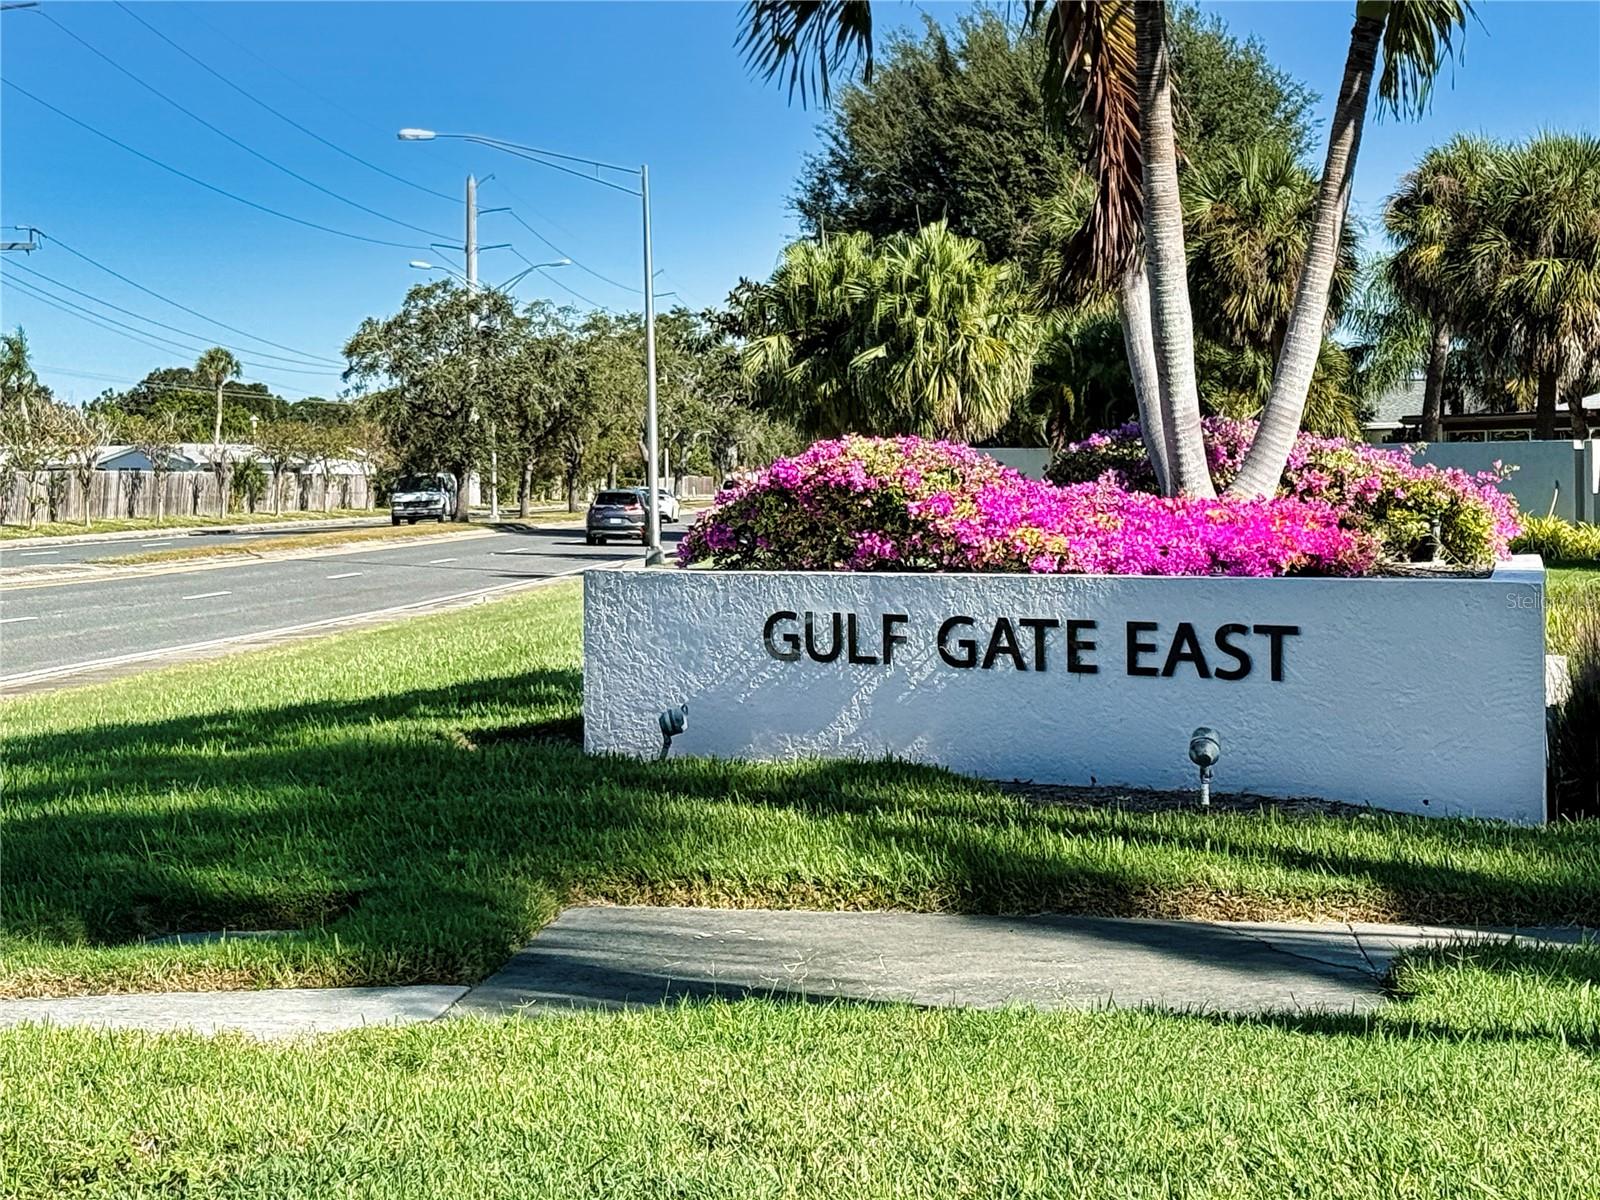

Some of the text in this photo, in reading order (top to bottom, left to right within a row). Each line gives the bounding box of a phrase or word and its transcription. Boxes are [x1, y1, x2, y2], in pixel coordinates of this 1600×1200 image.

[763, 611, 1300, 682] GULF GATE EAST
